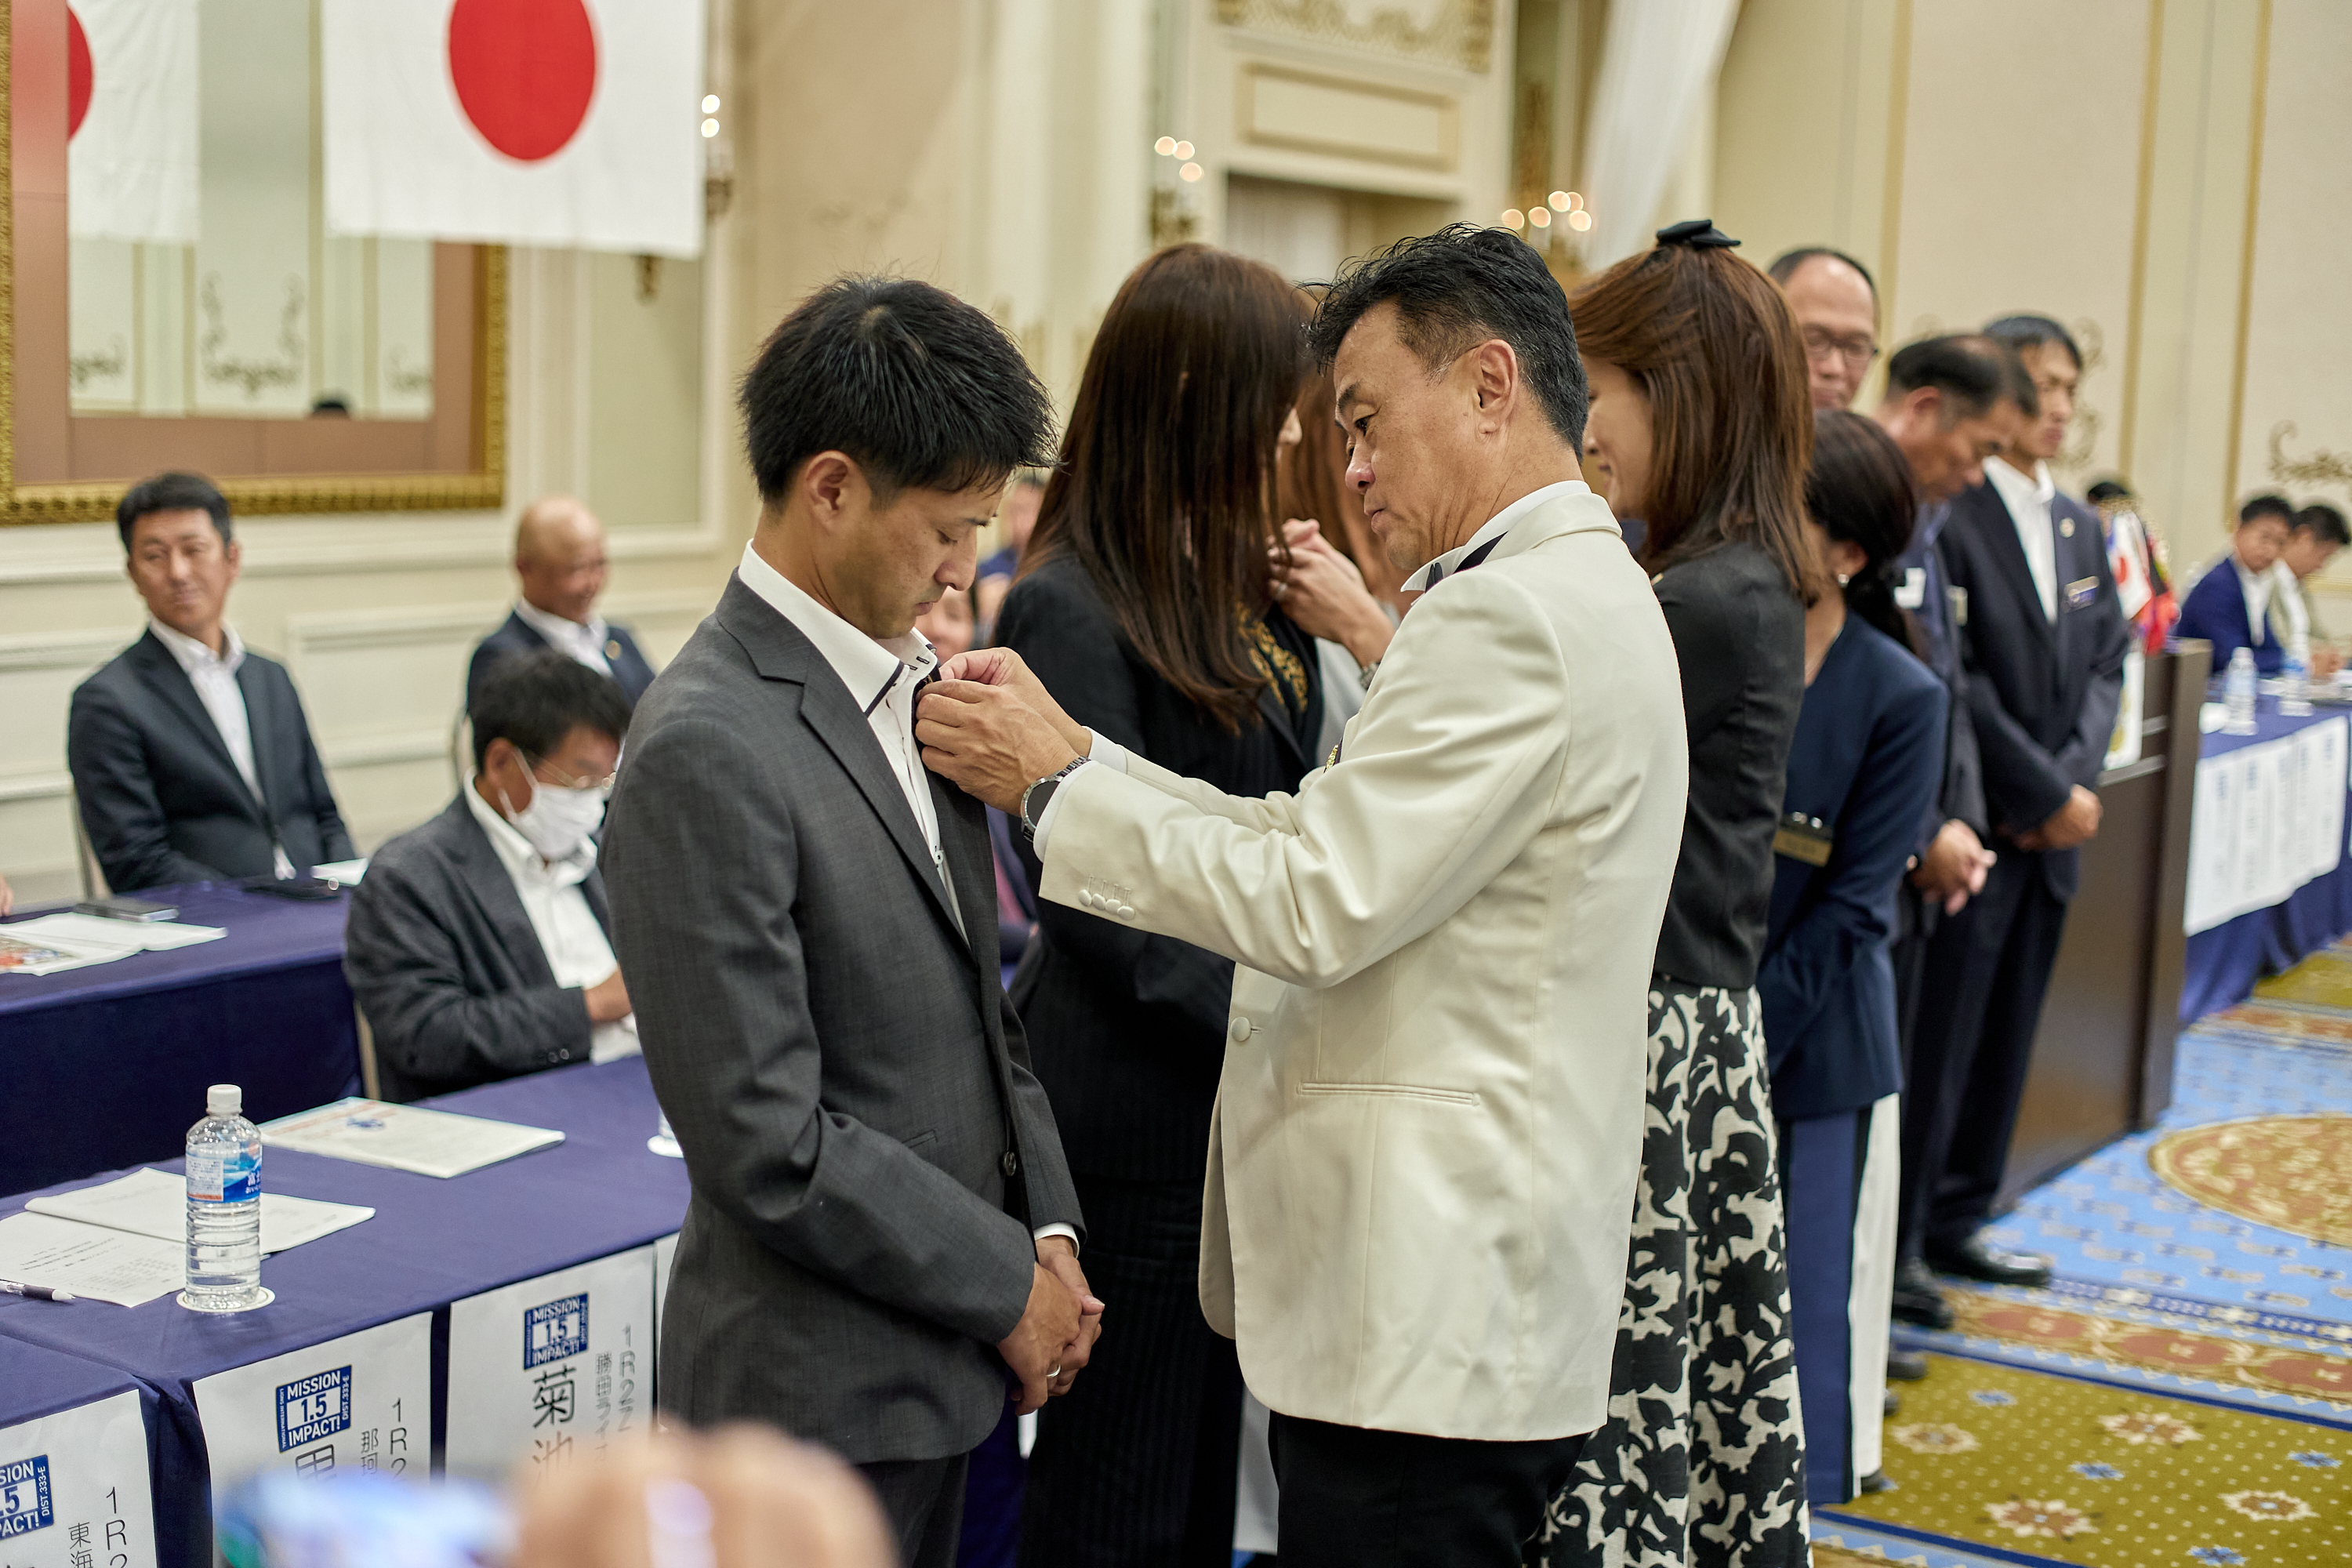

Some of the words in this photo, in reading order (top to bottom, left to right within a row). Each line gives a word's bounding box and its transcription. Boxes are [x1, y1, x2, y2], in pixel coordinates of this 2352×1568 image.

[532, 1297, 580, 1323] MISSION
[545, 1317, 568, 1345] 1.5
[533, 1339, 579, 1366] IMPACT!
[287, 1370, 341, 1400] MISSION
[341, 1374, 350, 1421] DIST.333-E
[301, 1392, 327, 1423] 1.5
[289, 1415, 340, 1446] IMPACT!
[37, 1465, 50, 1517] DIST.333-E
[0, 1504, 40, 1537] ACT!
